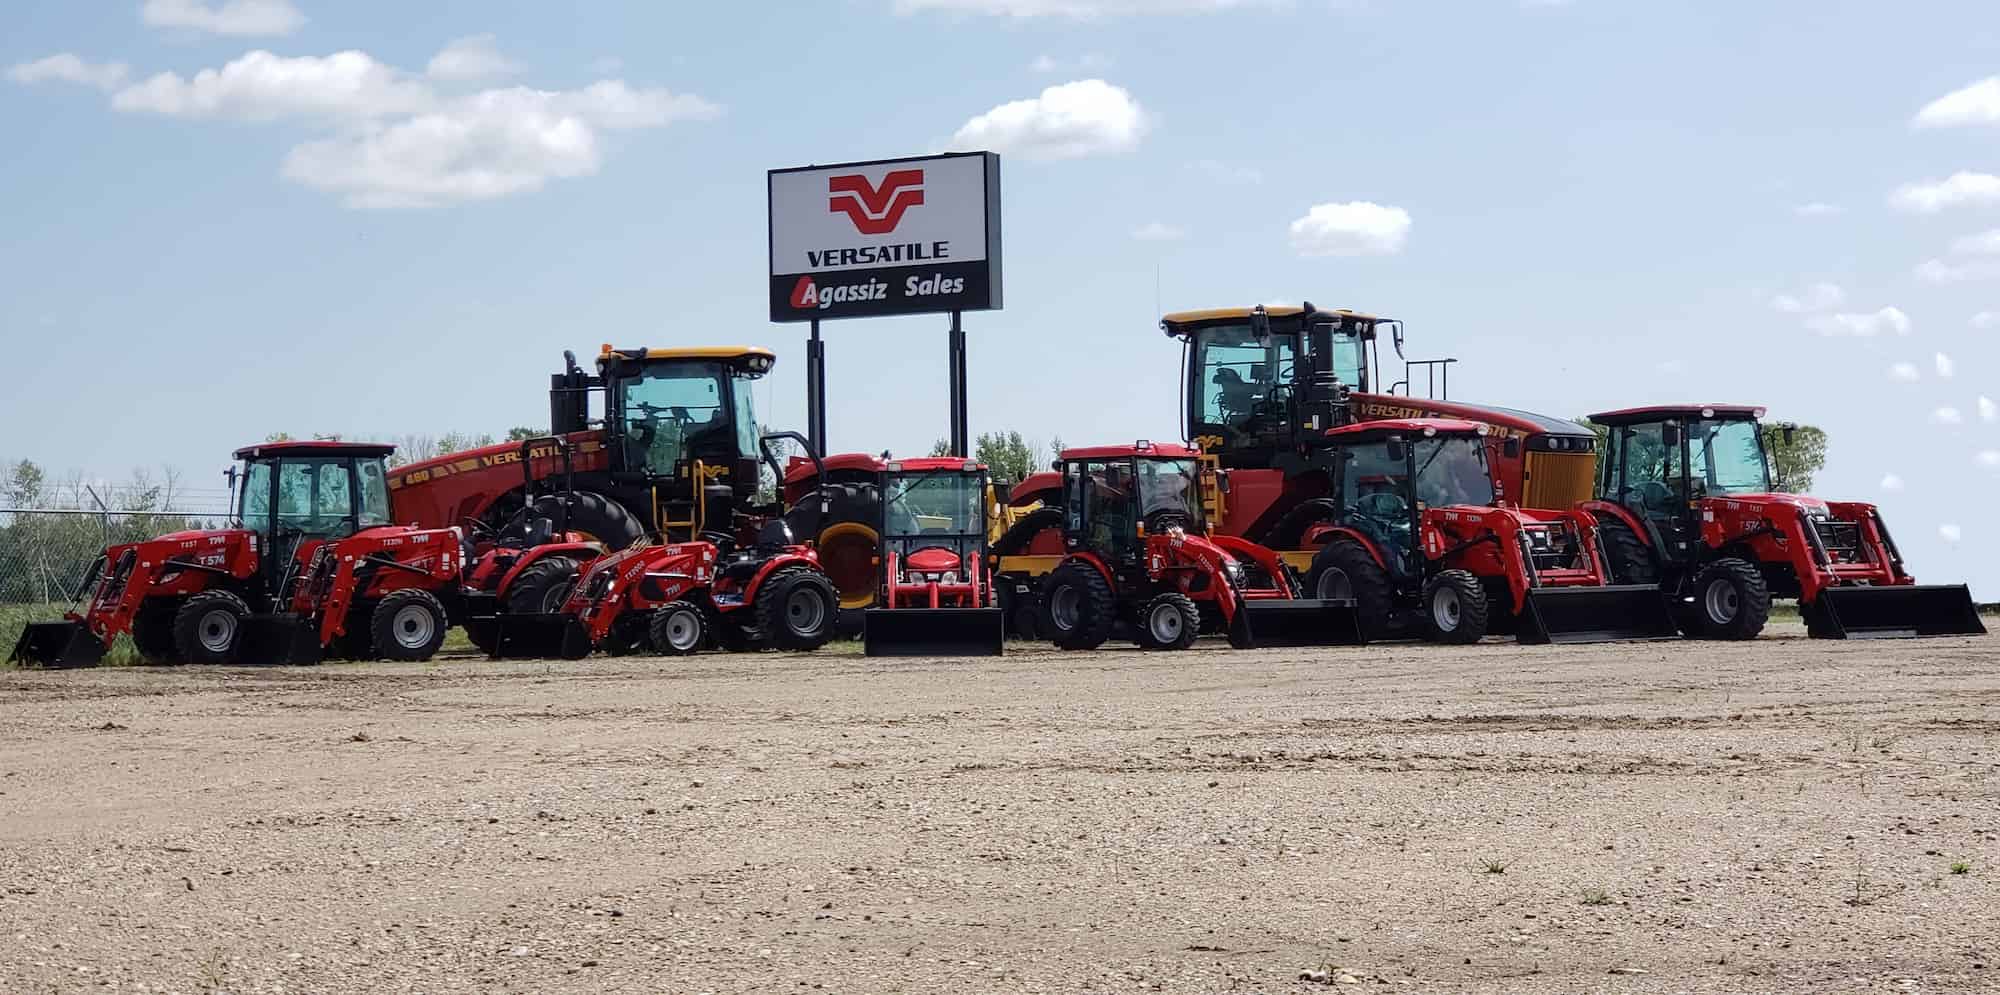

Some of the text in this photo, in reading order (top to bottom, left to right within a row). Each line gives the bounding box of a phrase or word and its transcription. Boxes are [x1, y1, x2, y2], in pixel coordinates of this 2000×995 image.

[807, 241, 949, 267] VERSATILE
[800, 273, 964, 309] Agassiz Sales
